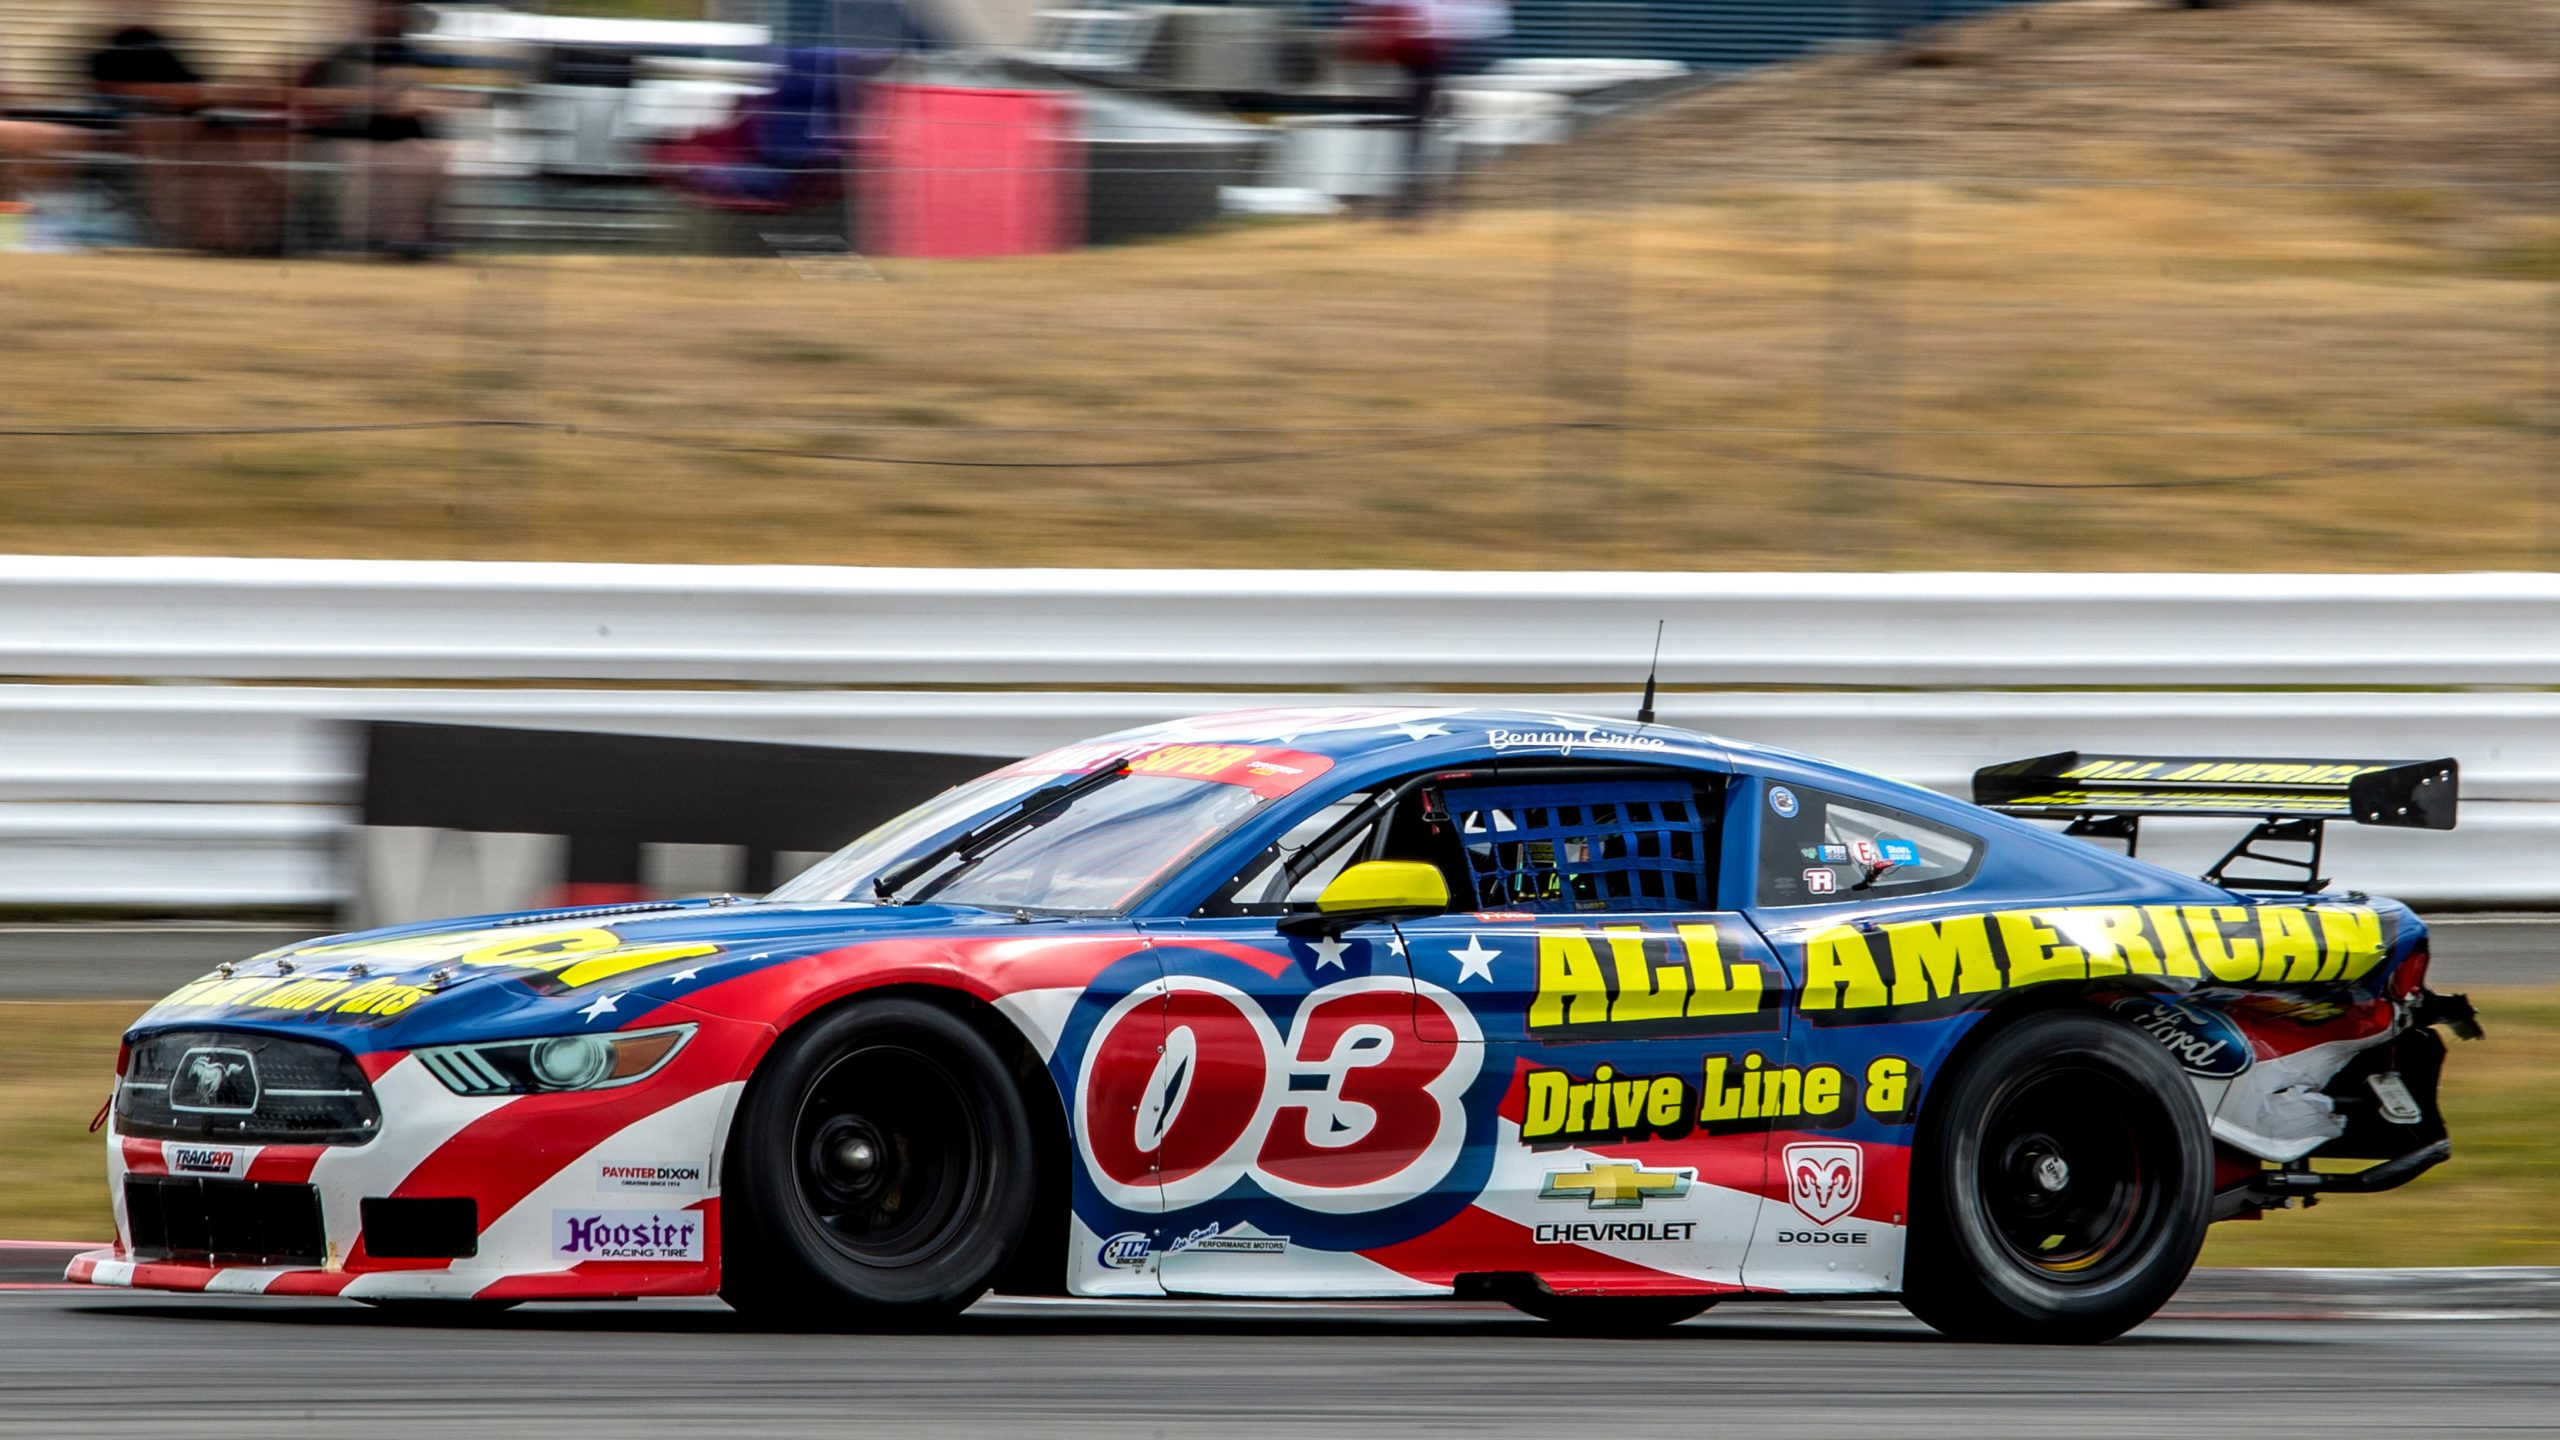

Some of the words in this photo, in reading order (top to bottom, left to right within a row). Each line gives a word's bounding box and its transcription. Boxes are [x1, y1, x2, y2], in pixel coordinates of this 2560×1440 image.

[1486, 729, 1578, 756] Benny
[1584, 729, 1664, 748] Grice
[1131, 746, 1257, 776] SUPER
[2057, 760, 2165, 780] ALL
[2157, 763, 2389, 783] AMERICA
[1529, 924, 1762, 1027] ALL
[1800, 905, 2382, 1009] AMERICAN
[2133, 1004, 2228, 1066] Ford
[1078, 982, 1470, 1200] 03
[1523, 1065, 1684, 1138] Drive
[1701, 1053, 1841, 1121] Line
[1865, 1058, 1907, 1112] &
[602, 1166, 656, 1179] PAYNTER
[657, 1168, 699, 1180] DIXON
[560, 1214, 695, 1252] Hoosier
[1190, 1224, 1218, 1243] Small
[1198, 1240, 1251, 1249] PERFORMANCE
[1252, 1241, 1284, 1249] MOTORS
[1535, 1222, 1697, 1242] CHEVROLET
[1778, 1231, 1868, 1244] DODGE
[602, 1248, 654, 1257] RACING
[659, 1248, 688, 1257] TIRE
